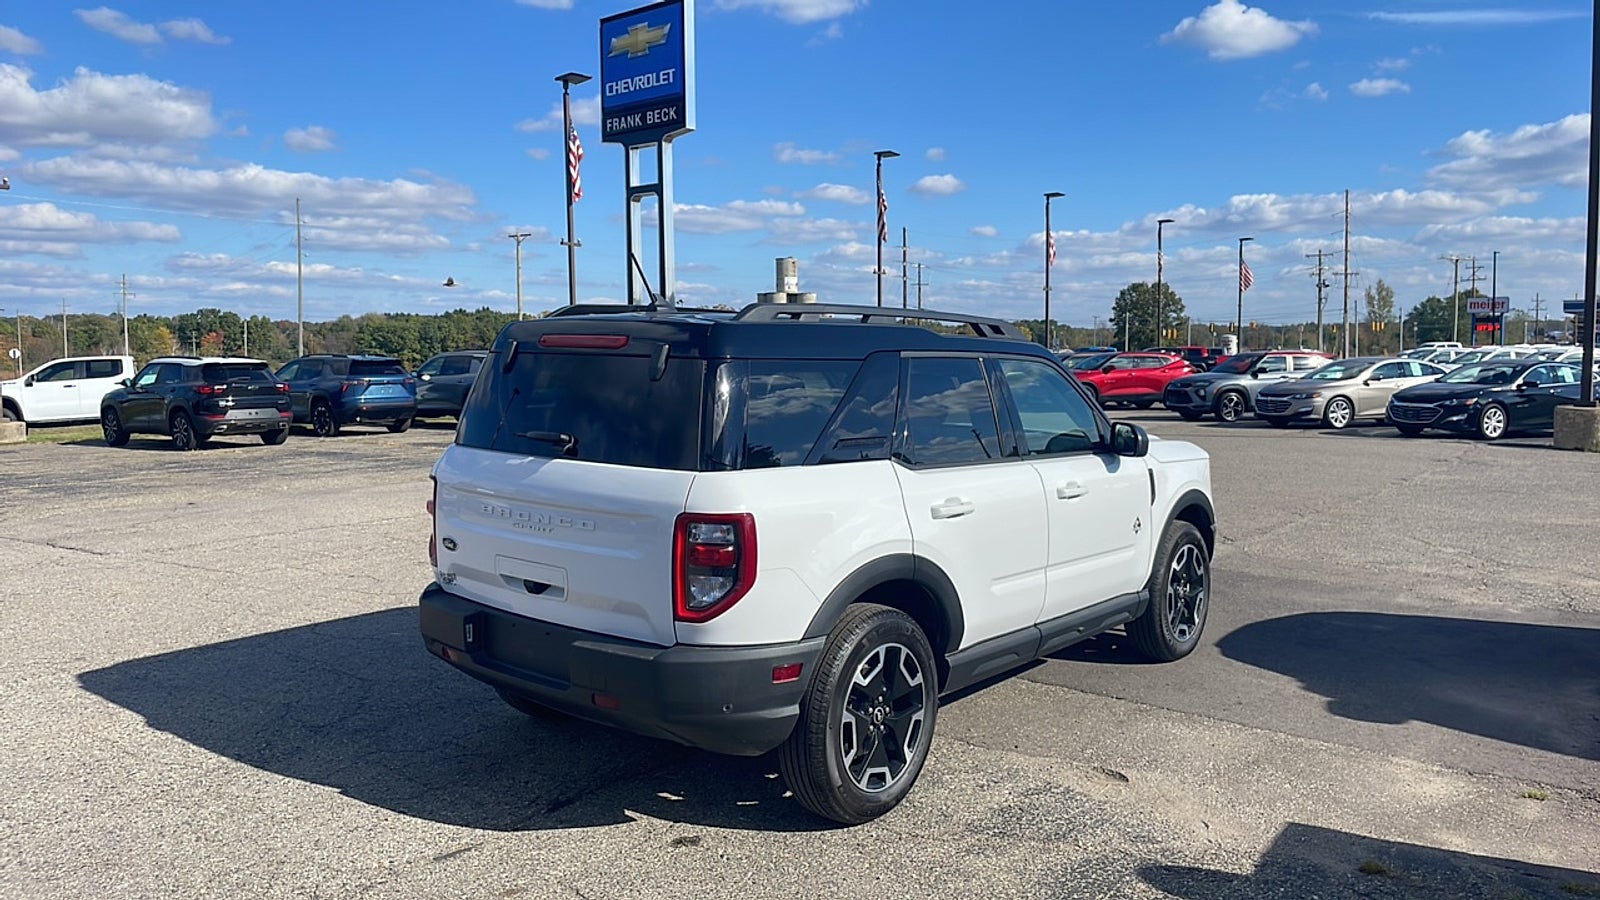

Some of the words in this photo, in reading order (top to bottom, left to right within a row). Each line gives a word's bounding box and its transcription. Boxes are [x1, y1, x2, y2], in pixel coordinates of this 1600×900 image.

[605, 68, 675, 97] CHEVROLET
[606, 112, 642, 132] FRANK
[646, 106, 677, 125] BECK
[481, 503, 597, 531] BRONCO
